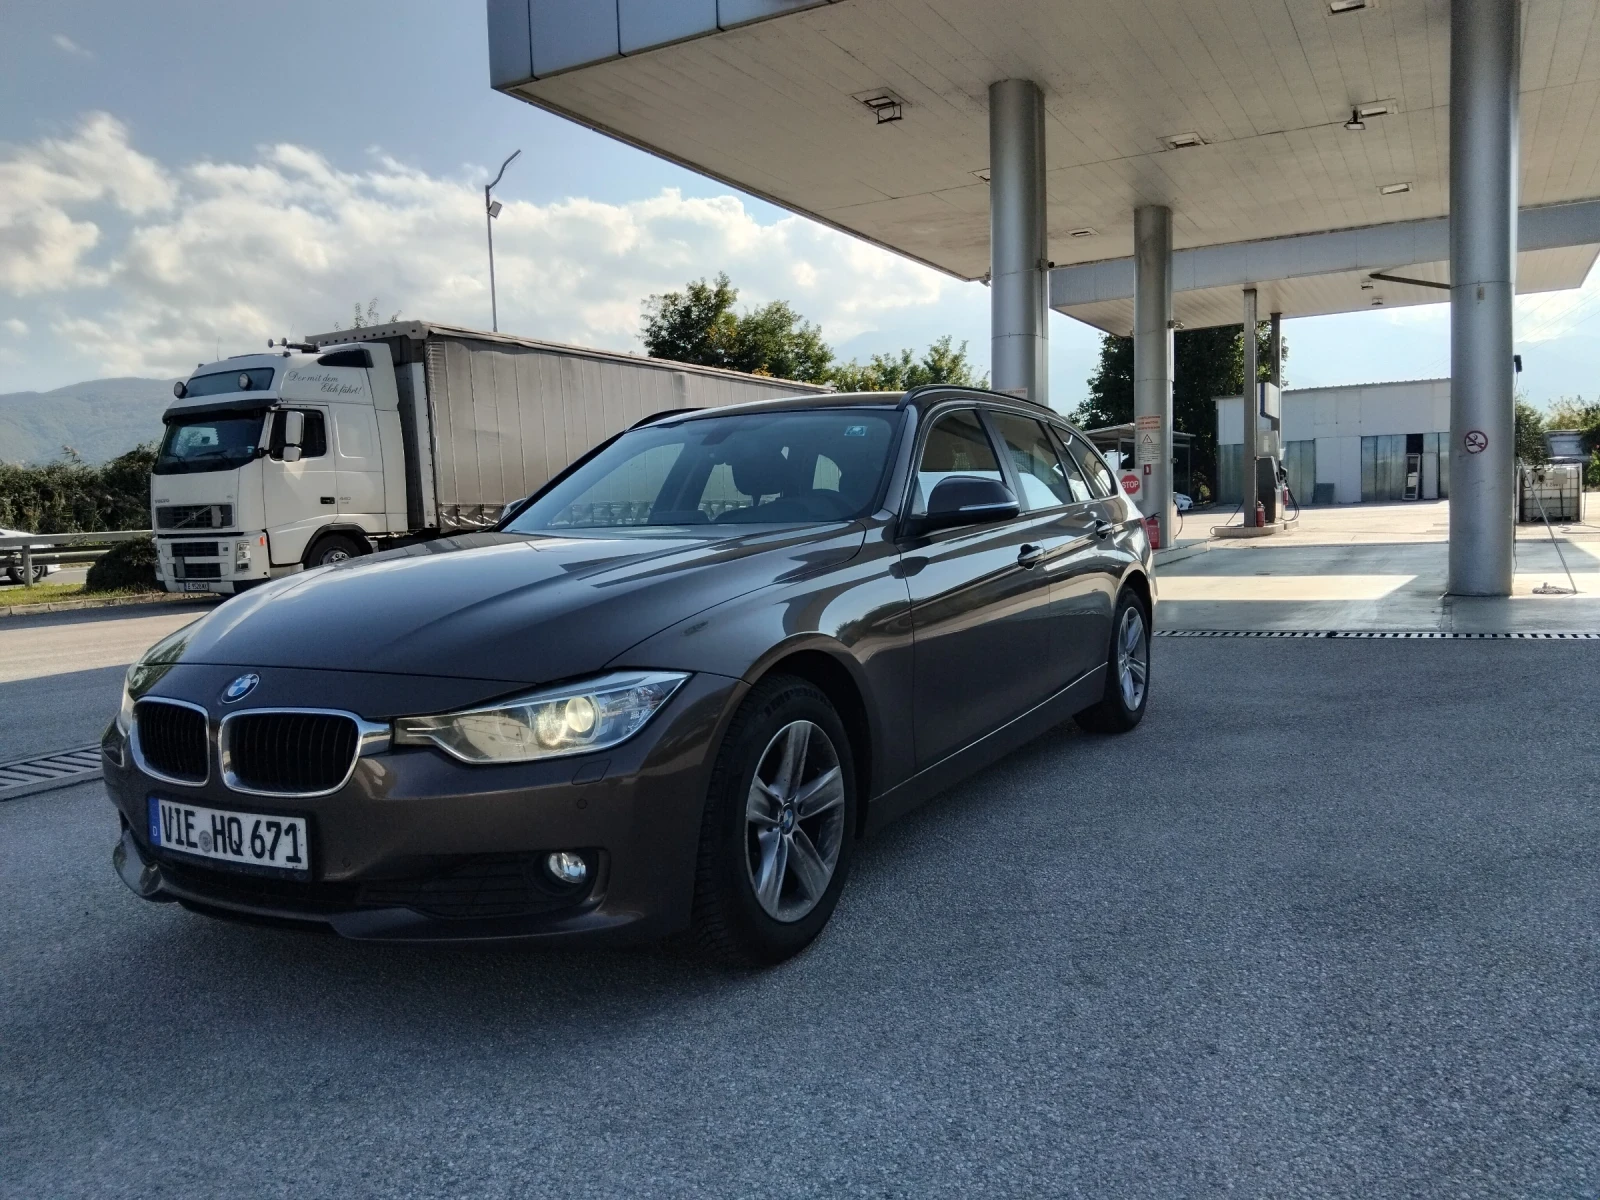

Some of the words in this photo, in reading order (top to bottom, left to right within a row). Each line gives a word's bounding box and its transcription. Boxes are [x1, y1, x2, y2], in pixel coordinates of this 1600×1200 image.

[288, 371, 306, 381] Der
[322, 373, 338, 382] dem
[320, 382, 338, 393] Elch
[338, 384, 362, 396] fährt!
[1121, 481, 1139, 489] STOP
[152, 825, 158, 837] D
[161, 804, 199, 849] VIE
[211, 814, 244, 857] HQ
[250, 819, 302, 864] 671
